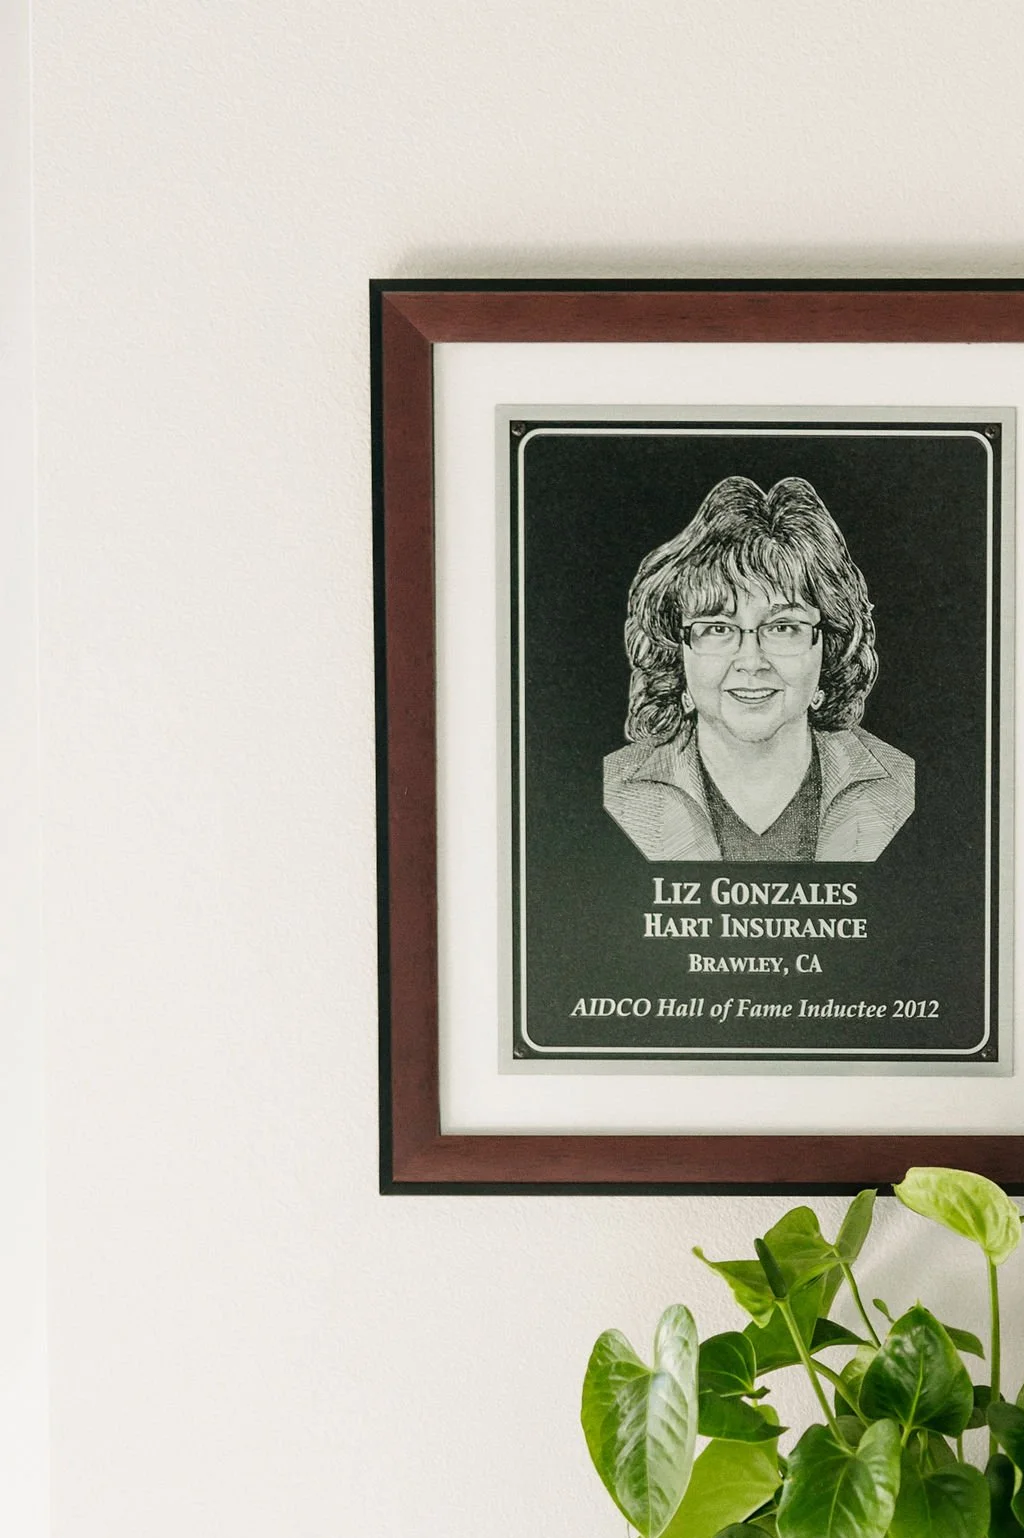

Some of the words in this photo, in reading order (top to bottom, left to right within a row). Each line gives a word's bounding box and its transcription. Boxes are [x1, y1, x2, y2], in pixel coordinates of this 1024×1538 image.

[795, 953, 823, 973] CA
[570, 998, 652, 1017] AIDCO
[655, 998, 705, 1018] Hall
[709, 998, 734, 1023] of
[735, 998, 793, 1018] Fame
[798, 999, 887, 1018] Inductee
[892, 999, 940, 1019] 2012
